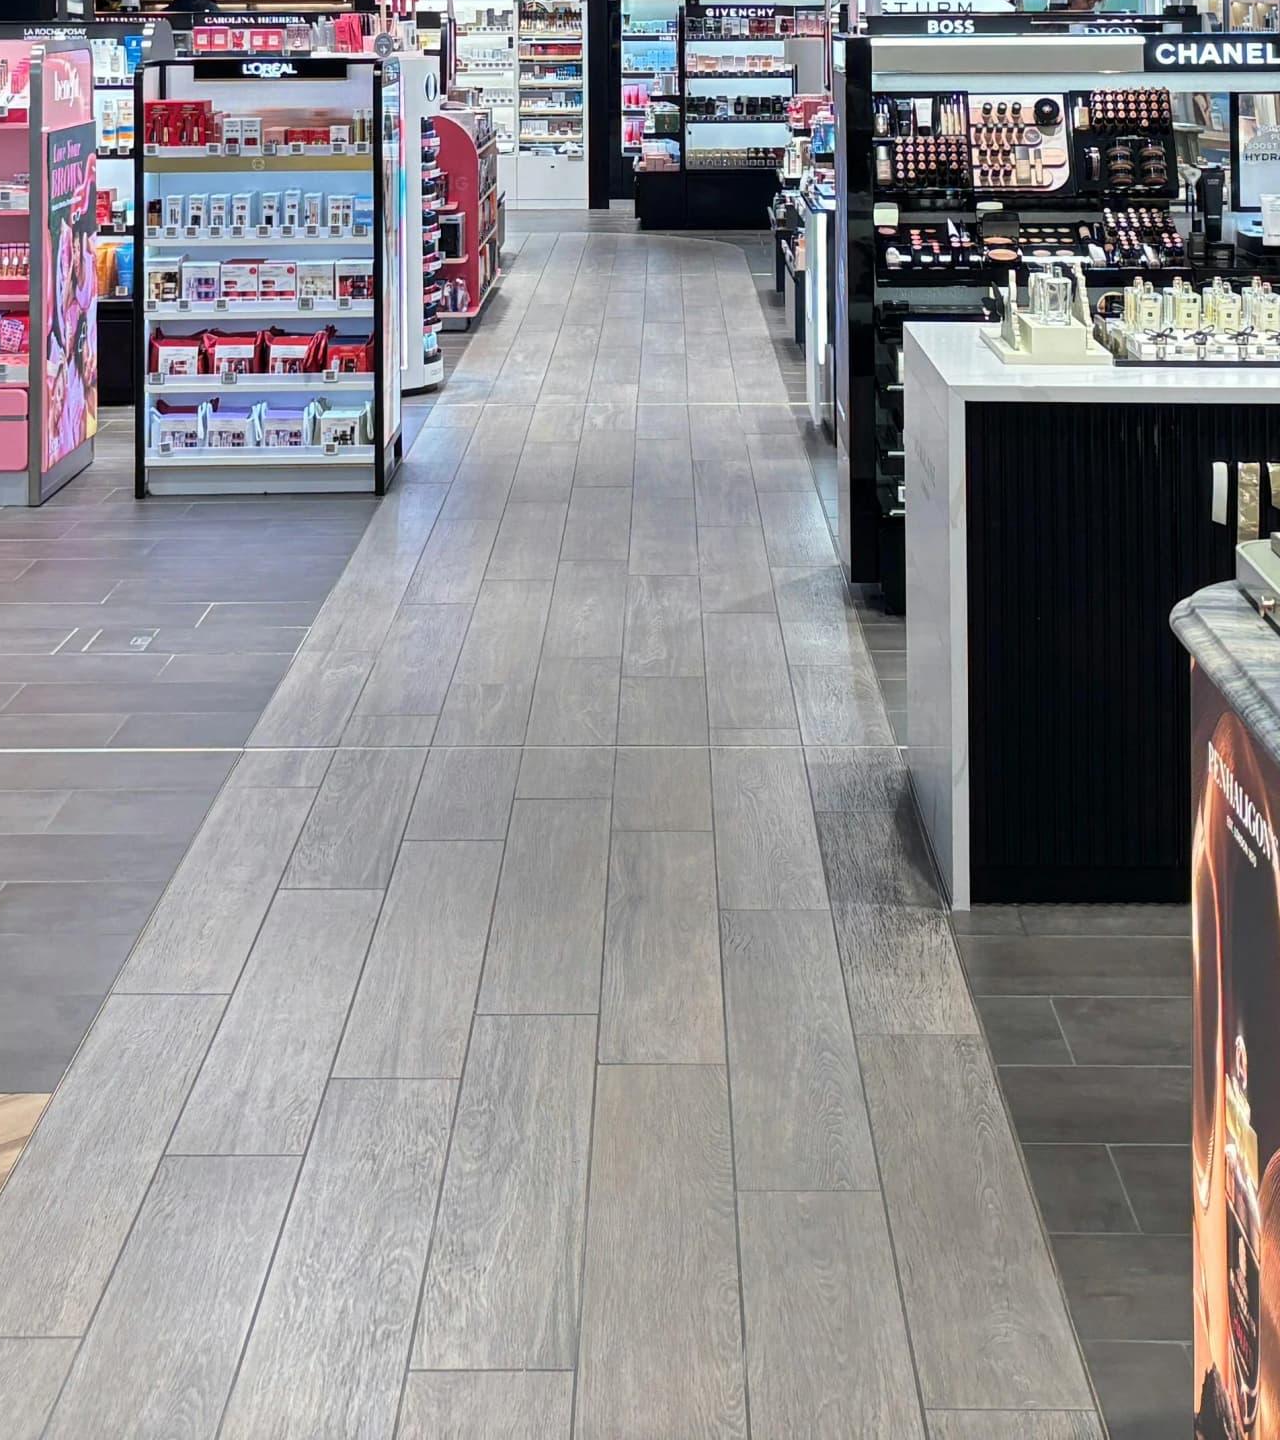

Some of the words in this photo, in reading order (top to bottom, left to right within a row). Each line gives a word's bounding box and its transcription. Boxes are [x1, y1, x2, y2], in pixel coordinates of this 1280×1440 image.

[204, 16, 255, 24] CAROLINA
[257, 16, 306, 24] HERRERA
[705, 8, 775, 17] GIVENCHY
[927, 19, 975, 34] BOSS
[51, 160, 84, 199] BROWS
[1208, 740, 1279, 865] PENHALIGON'S
